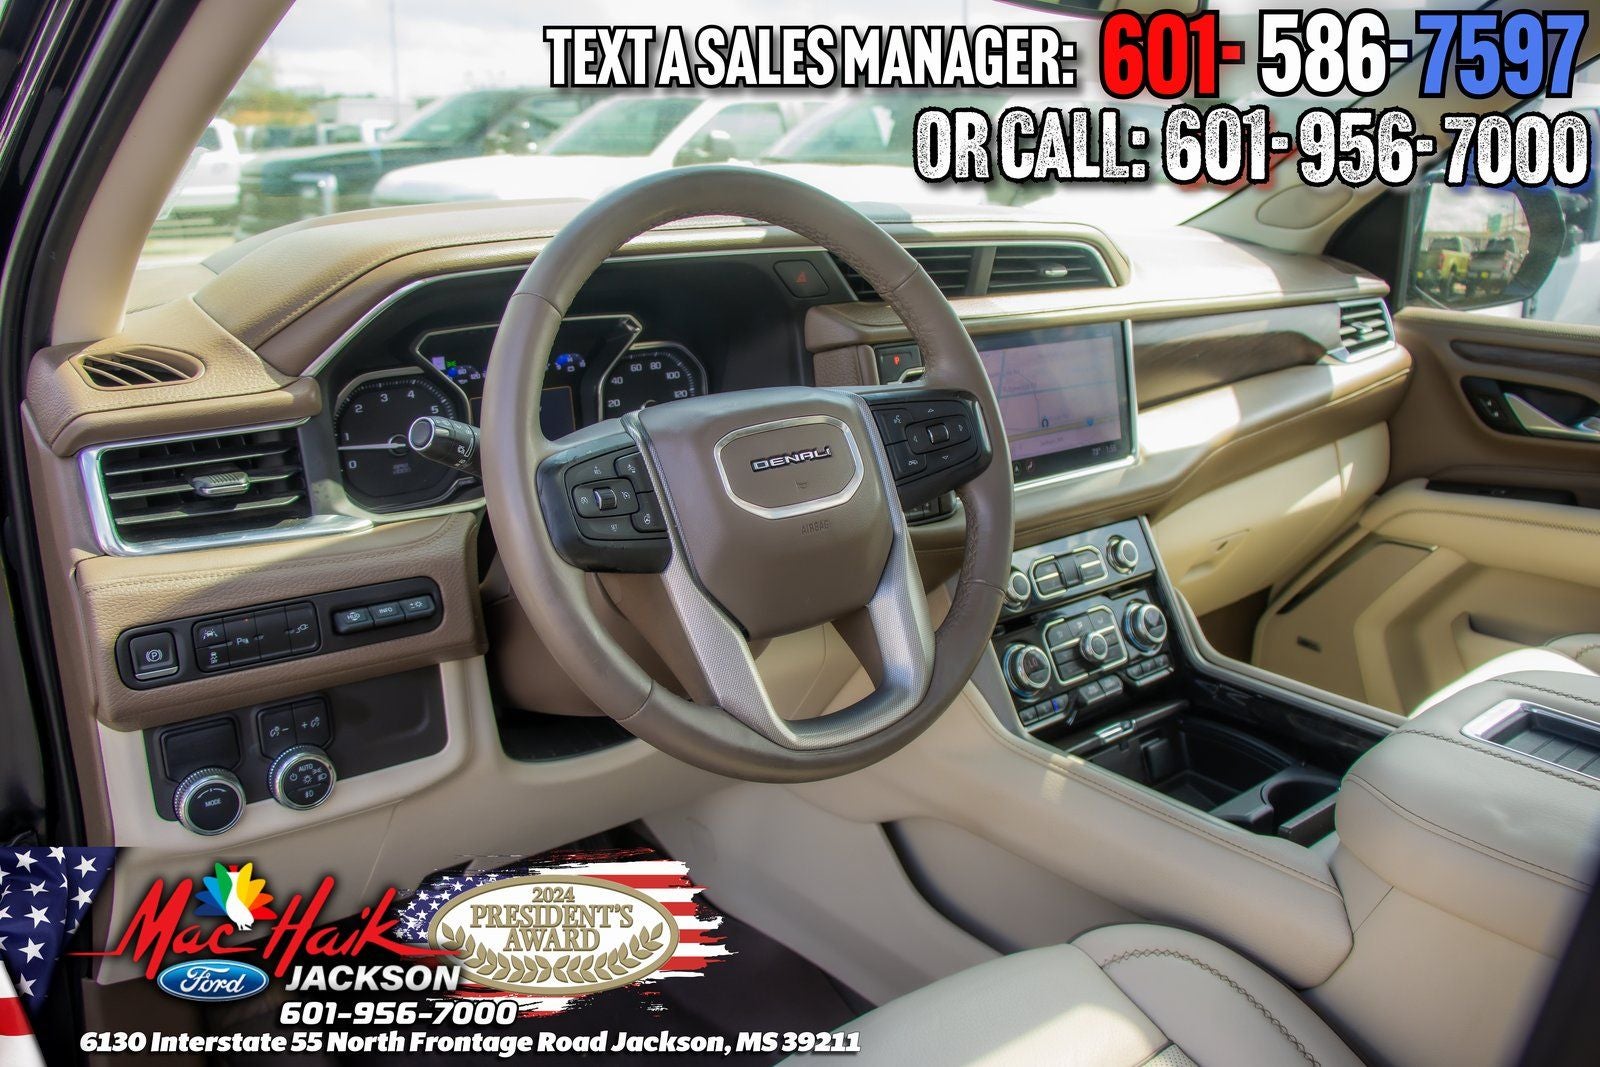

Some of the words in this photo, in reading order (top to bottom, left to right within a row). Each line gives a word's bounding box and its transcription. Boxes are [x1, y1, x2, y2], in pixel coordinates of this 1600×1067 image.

[631, 364, 642, 372] 60
[666, 371, 680, 380] 100
[611, 377, 623, 385] 40
[380, 393, 389, 403] 3
[407, 390, 415, 399] 4
[674, 390, 688, 399] 120
[608, 399, 620, 408] 20
[354, 404, 363, 413] 2
[430, 405, 439, 414] 5
[752, 447, 832, 471] DENALI
[348, 460, 357, 469] 0
[800, 519, 832, 537] AIRBAG
[298, 763, 314, 773] AUTO
[205, 799, 221, 808] MODE
